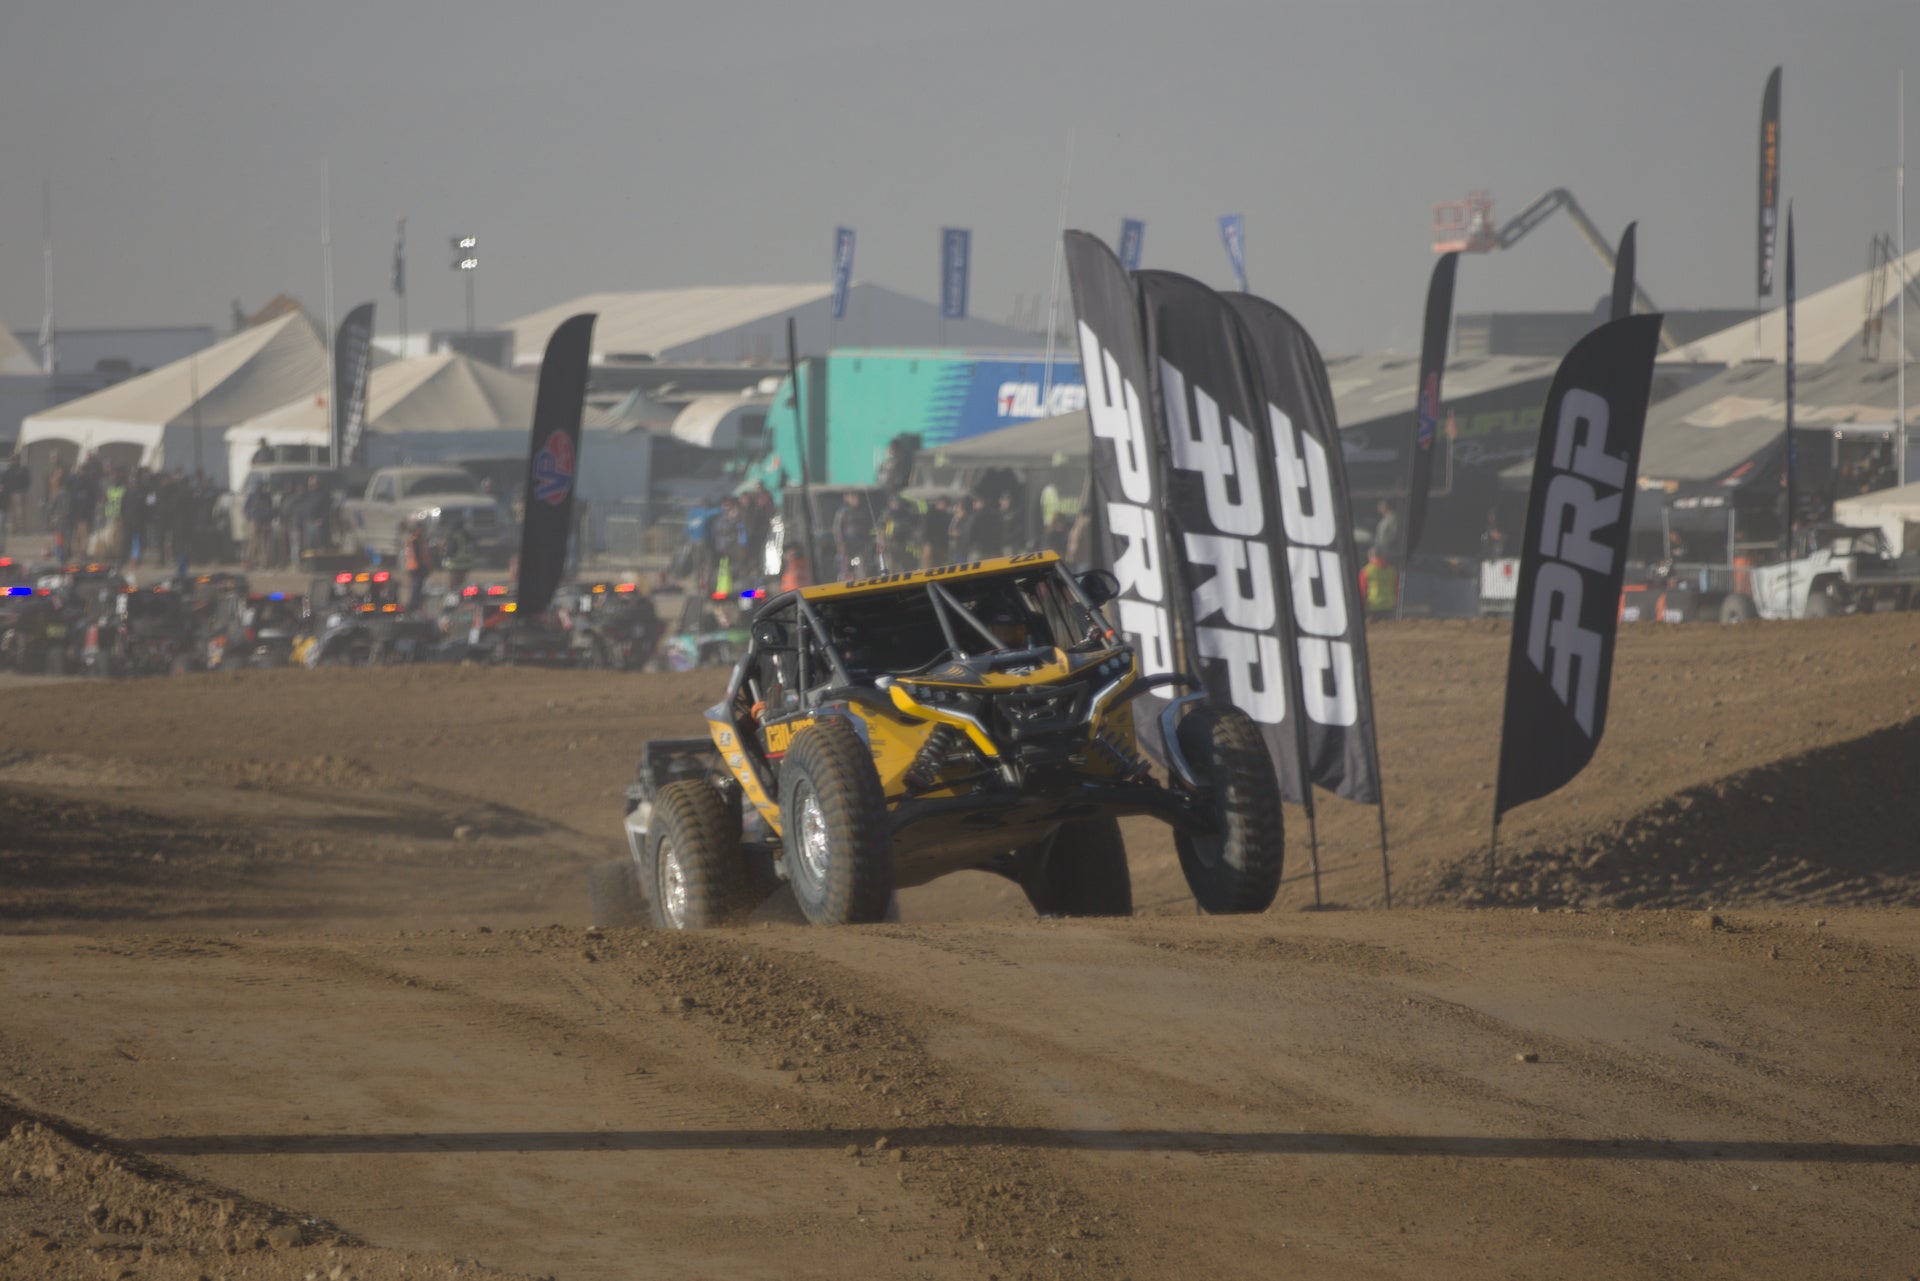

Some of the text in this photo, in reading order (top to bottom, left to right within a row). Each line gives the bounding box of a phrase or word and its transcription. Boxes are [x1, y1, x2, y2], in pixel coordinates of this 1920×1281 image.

[1078, 320, 1177, 699] PRP
[1159, 356, 1286, 724] PRP
[1527, 387, 1629, 740] PRP
